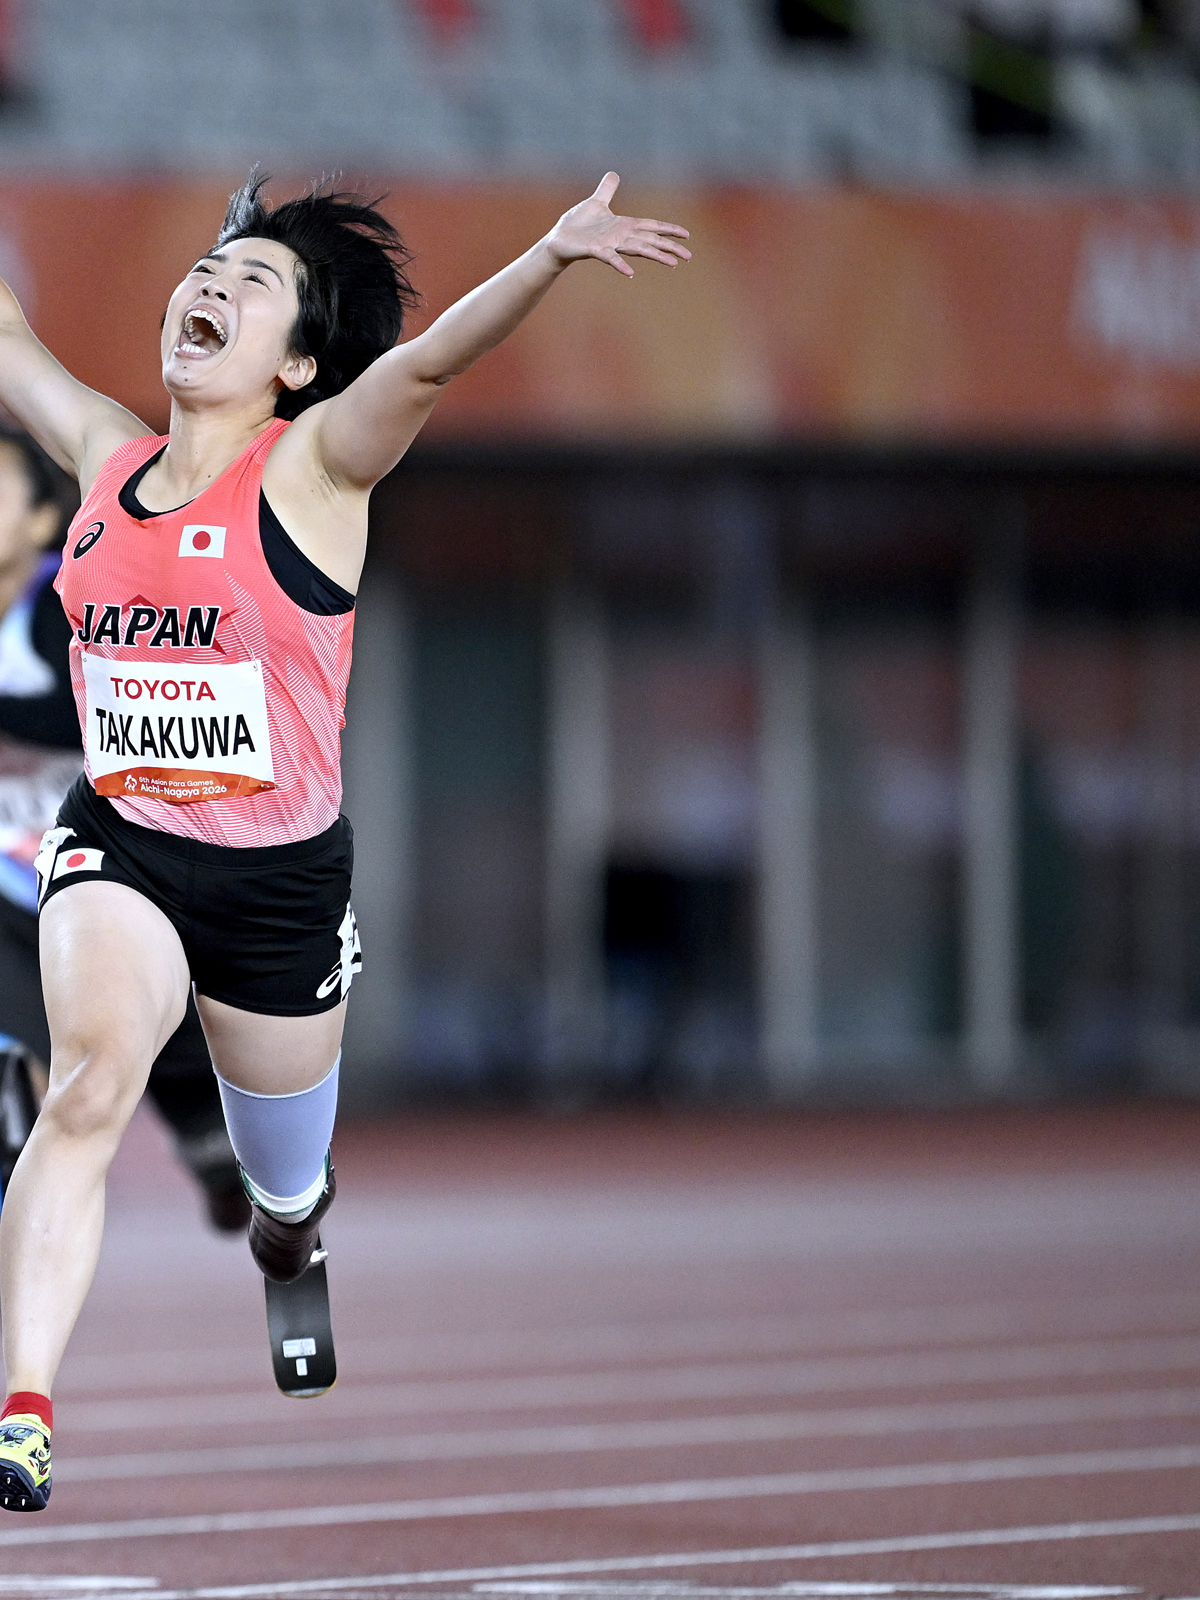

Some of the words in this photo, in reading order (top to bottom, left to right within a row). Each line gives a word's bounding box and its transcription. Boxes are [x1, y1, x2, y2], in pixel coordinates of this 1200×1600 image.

[77, 603, 221, 648] JAPAN
[110, 677, 216, 701] TOYOTA
[95, 707, 256, 759] TAKAKUWA
[140, 783, 200, 798] Aichi-Nagoya
[201, 785, 228, 795] 2026
[151, 778, 168, 786] Asian
[187, 779, 214, 787] Games
